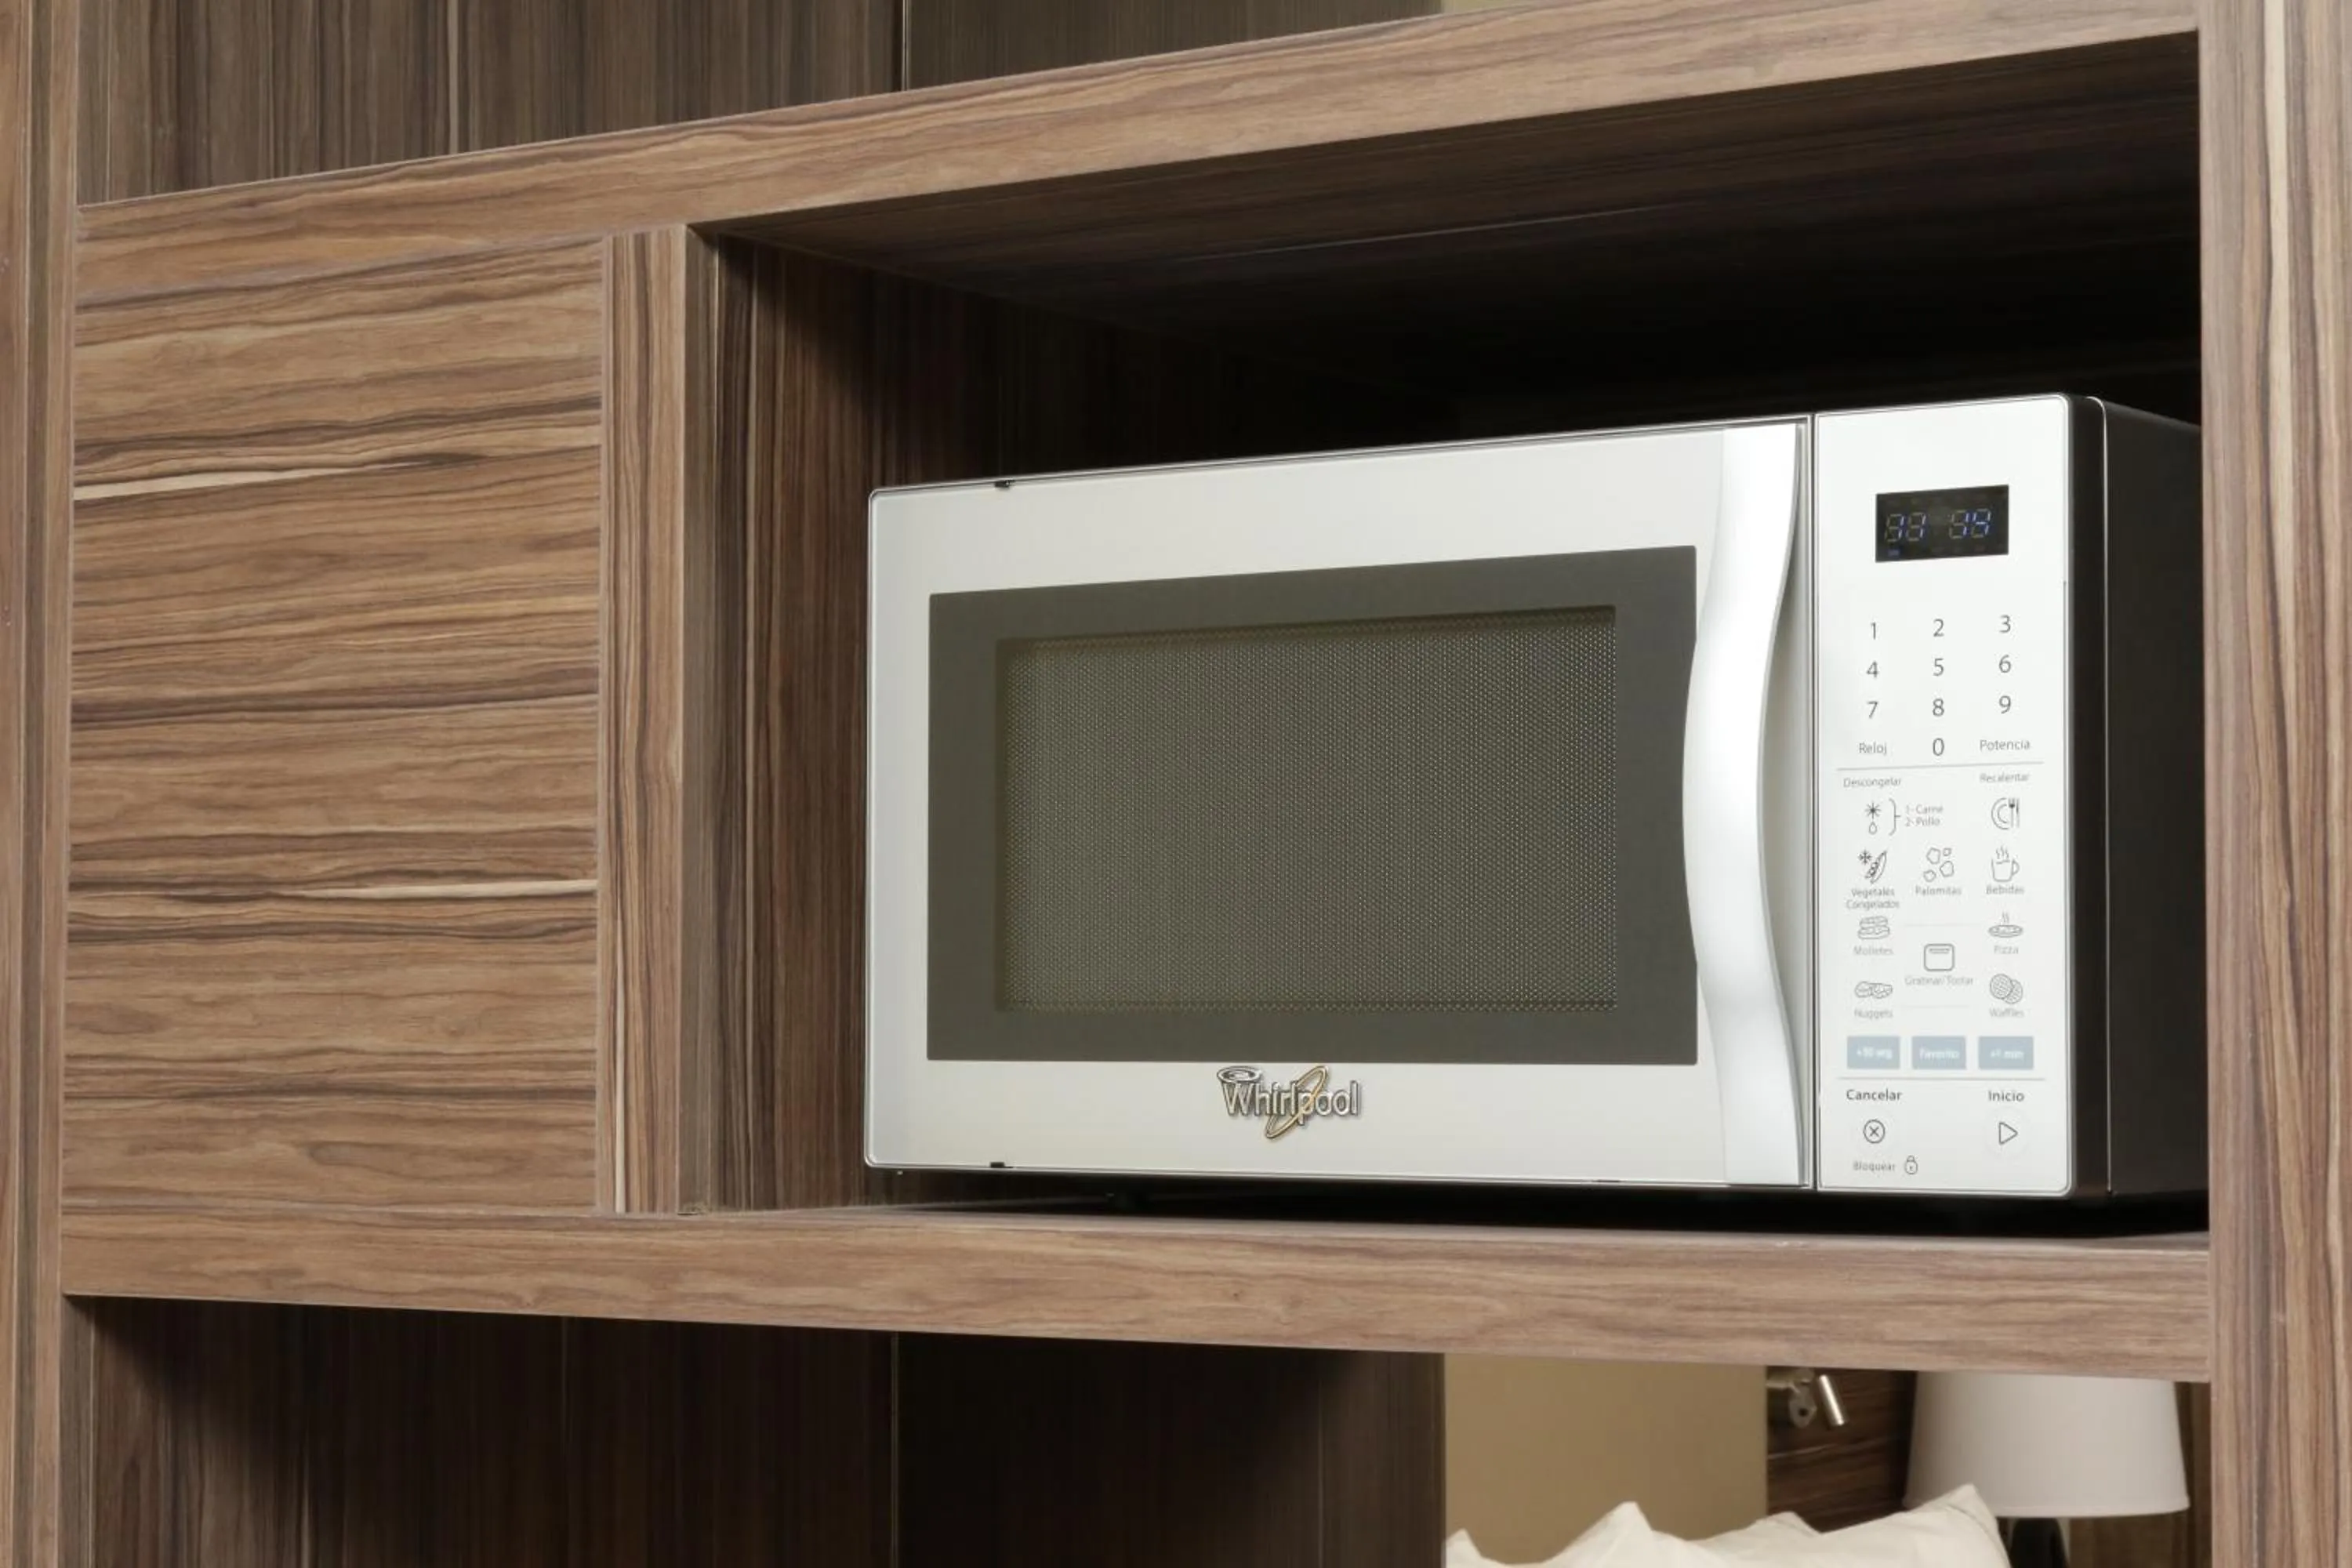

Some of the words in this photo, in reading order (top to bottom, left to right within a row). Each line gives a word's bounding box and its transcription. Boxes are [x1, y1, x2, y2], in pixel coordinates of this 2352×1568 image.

[1933, 618, 1944, 637] 2
[1998, 615, 2011, 633] 3
[1870, 622, 1877, 640] 1
[1866, 661, 1879, 678] 4
[1933, 658, 1944, 677] 5
[1998, 655, 2012, 673] 6
[1867, 701, 1878, 719] 7
[1932, 699, 1945, 717] 8
[1998, 695, 2012, 714] 9
[1859, 742, 1887, 755] Reloj
[1932, 738, 1945, 756] 0
[1979, 739, 2031, 752] Potencia
[1842, 776, 1901, 788] Descongelar
[1979, 771, 2030, 783] Recalentar
[1851, 887, 1896, 899] Vegetales
[1915, 885, 1962, 896] Palomitas
[1985, 884, 2025, 895] Bebidas
[1846, 898, 1900, 910] Congelados
[1993, 944, 2019, 955] Pizza
[1854, 1008, 1893, 1020] Nuggets
[1988, 1007, 2025, 1019] Waffles
[1217, 1066, 1361, 1126] Whirlpool
[1846, 1089, 1903, 1102] Cancelar
[1988, 1091, 2024, 1102] Inicio
[1853, 1161, 1896, 1174] Bloquear
